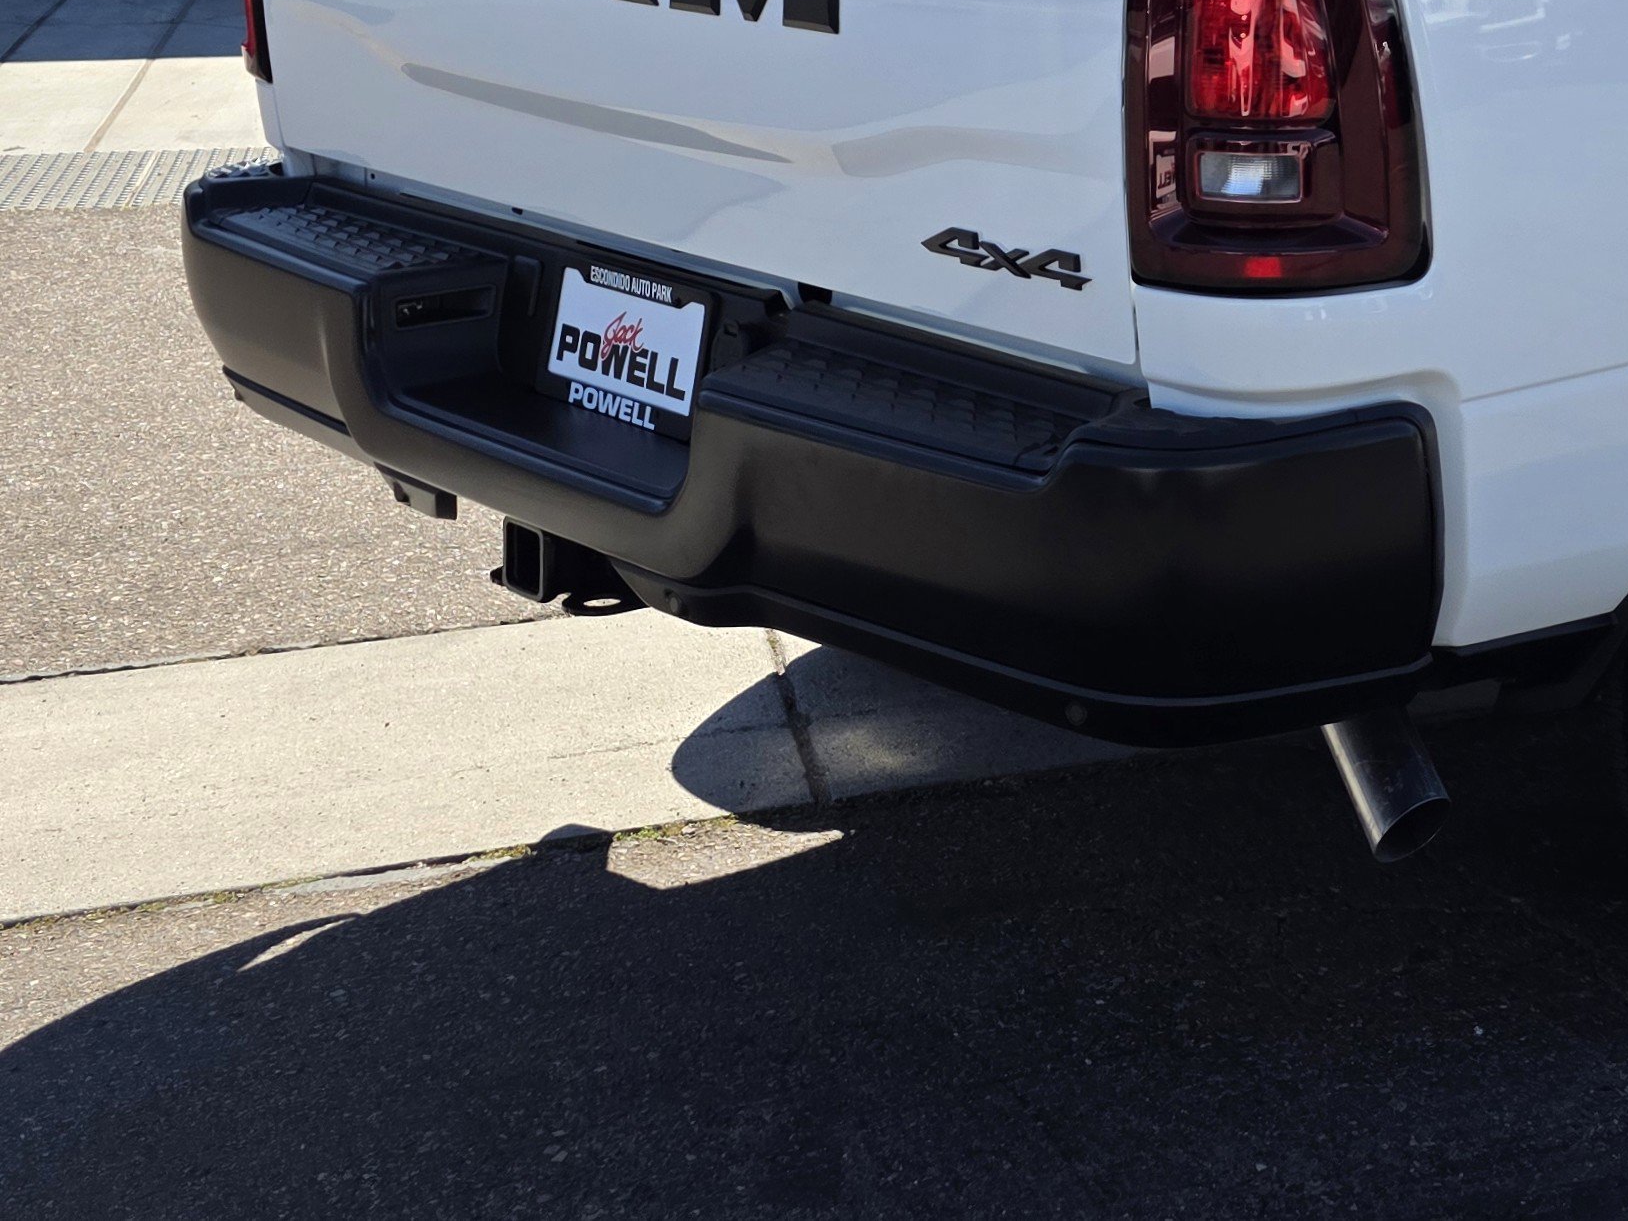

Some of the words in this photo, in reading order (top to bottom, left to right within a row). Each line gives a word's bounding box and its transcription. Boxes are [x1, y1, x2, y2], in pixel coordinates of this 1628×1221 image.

[590, 265, 630, 293] ESCONDIDO
[630, 277, 651, 298] AUTO
[651, 282, 674, 304] PARK
[601, 311, 645, 361] Jack
[555, 323, 686, 402] POWELL
[567, 381, 656, 431] POWELL
